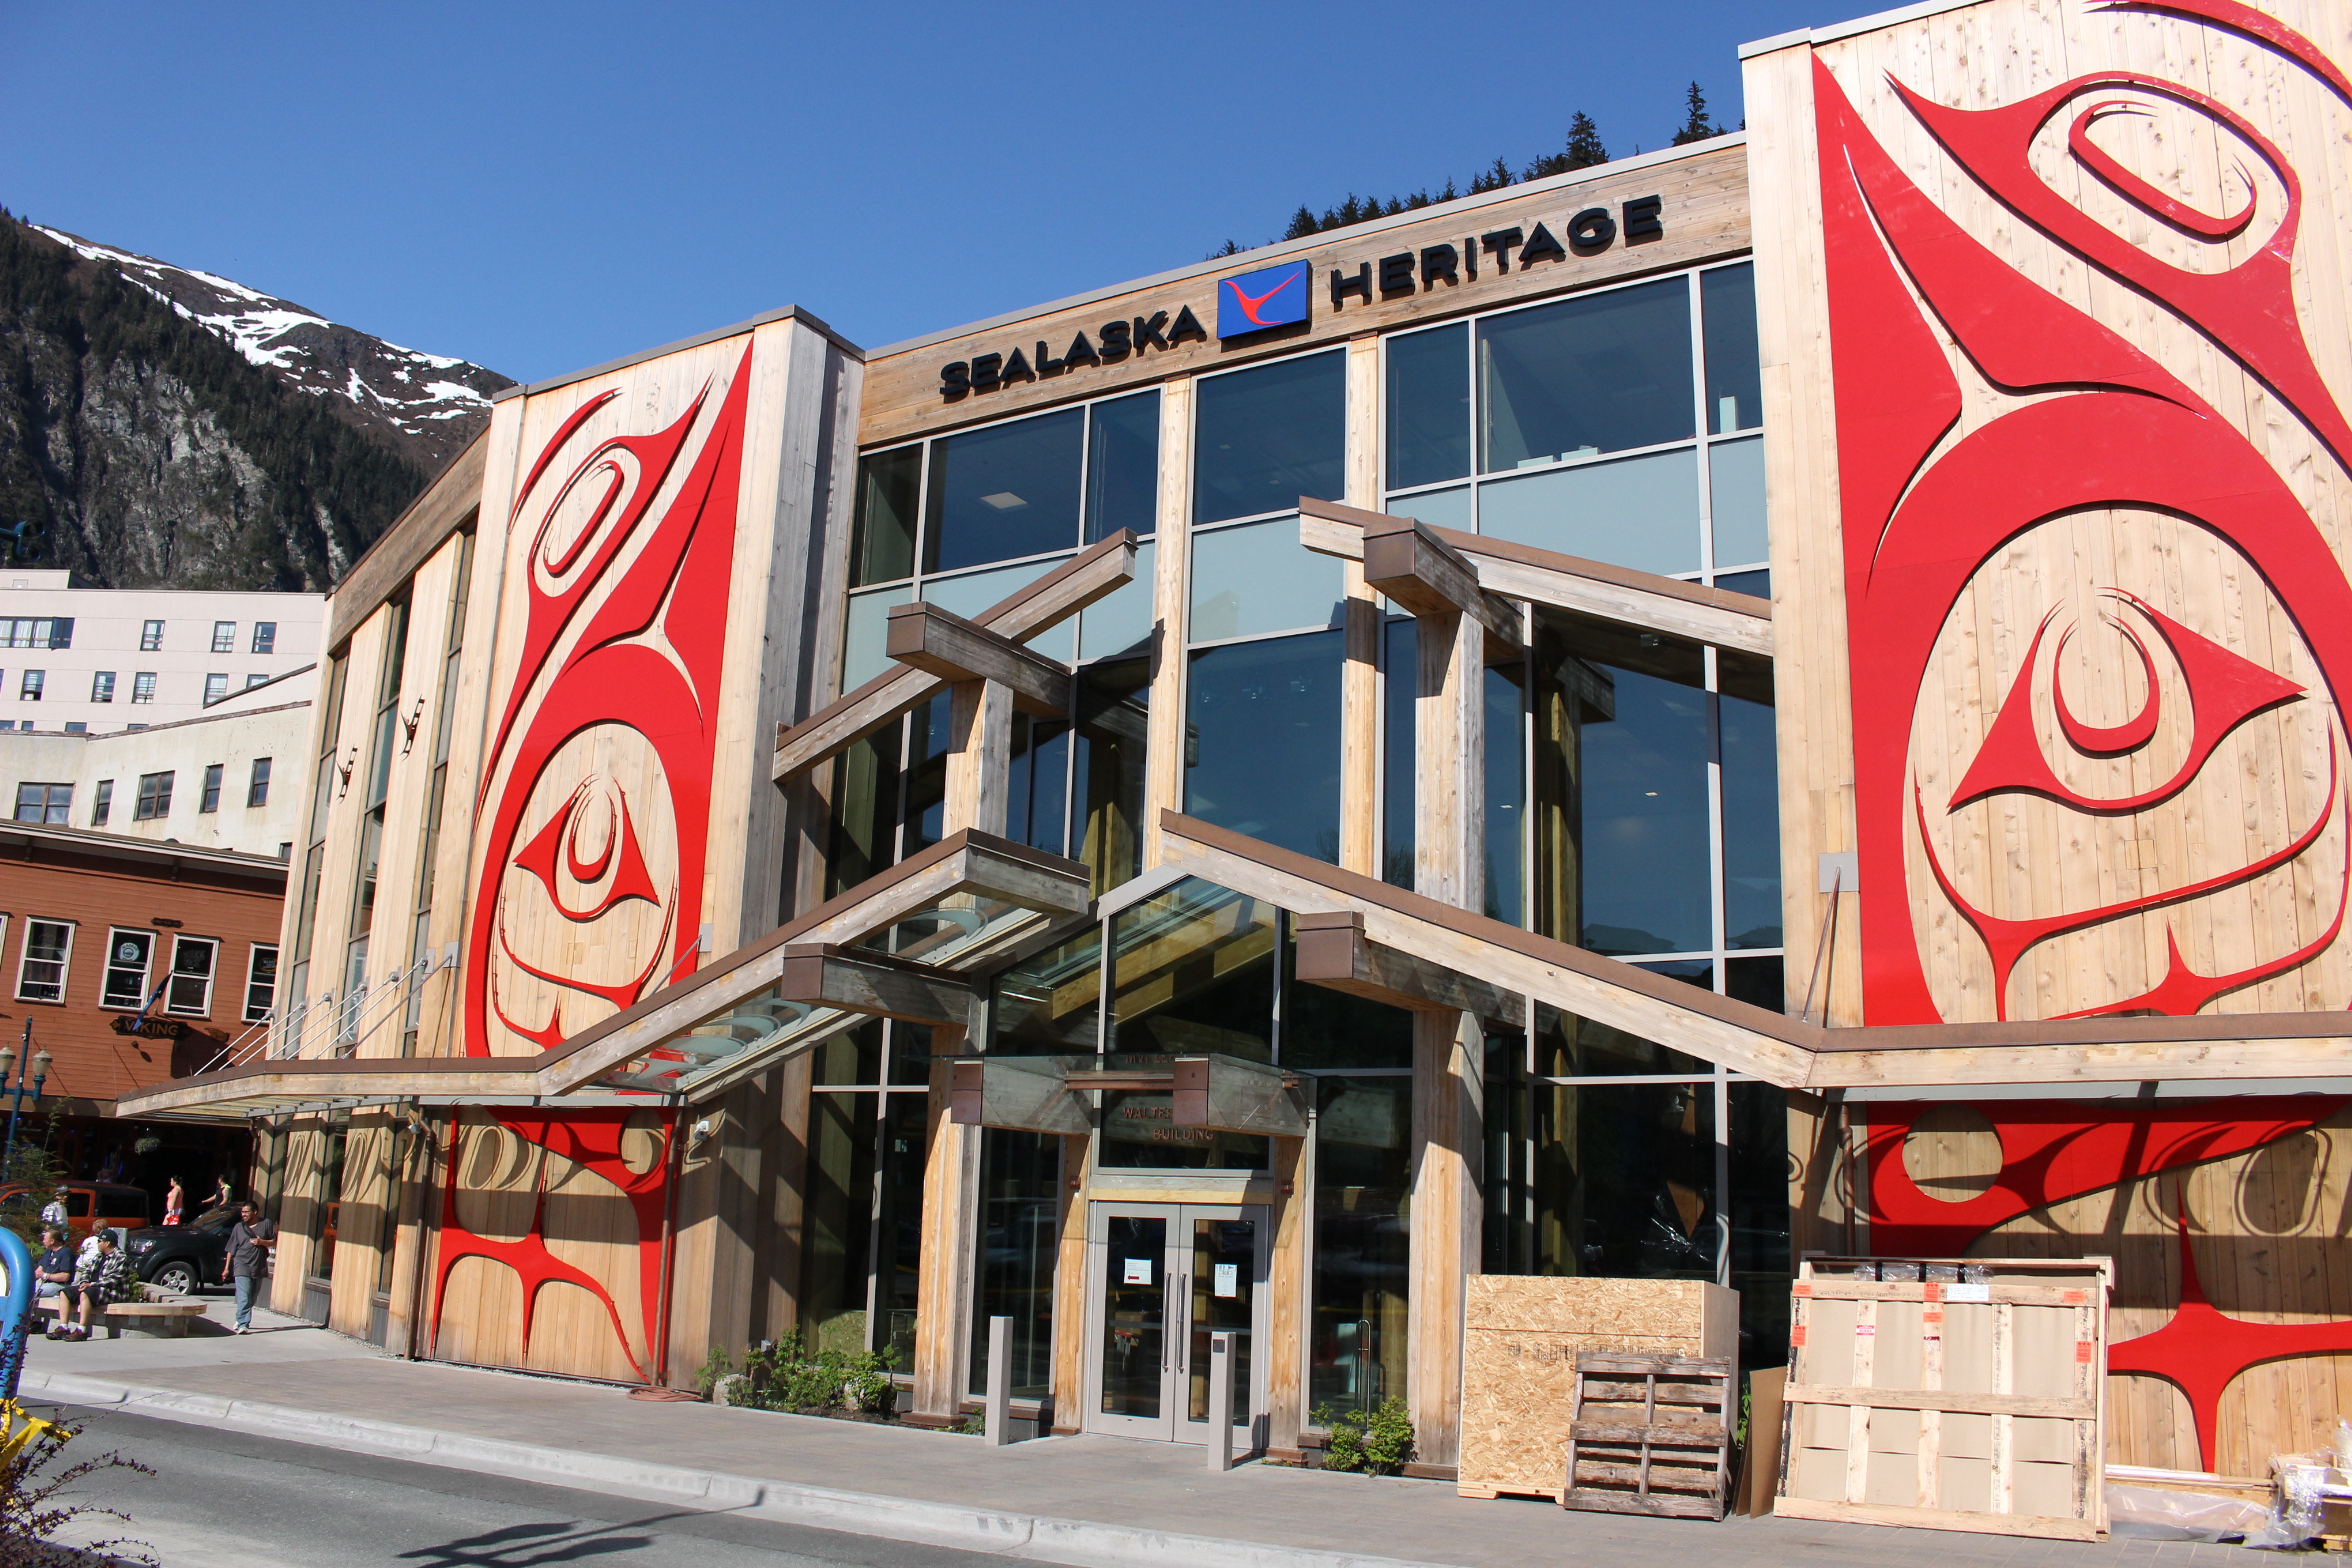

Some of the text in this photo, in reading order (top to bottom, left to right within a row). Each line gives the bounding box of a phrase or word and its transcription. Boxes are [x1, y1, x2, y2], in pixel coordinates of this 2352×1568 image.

[940, 194, 1663, 396] SEALASKA HERITAGE
[125, 1020, 178, 1035] VKING
[1153, 1128, 1214, 1141] BUILDING
